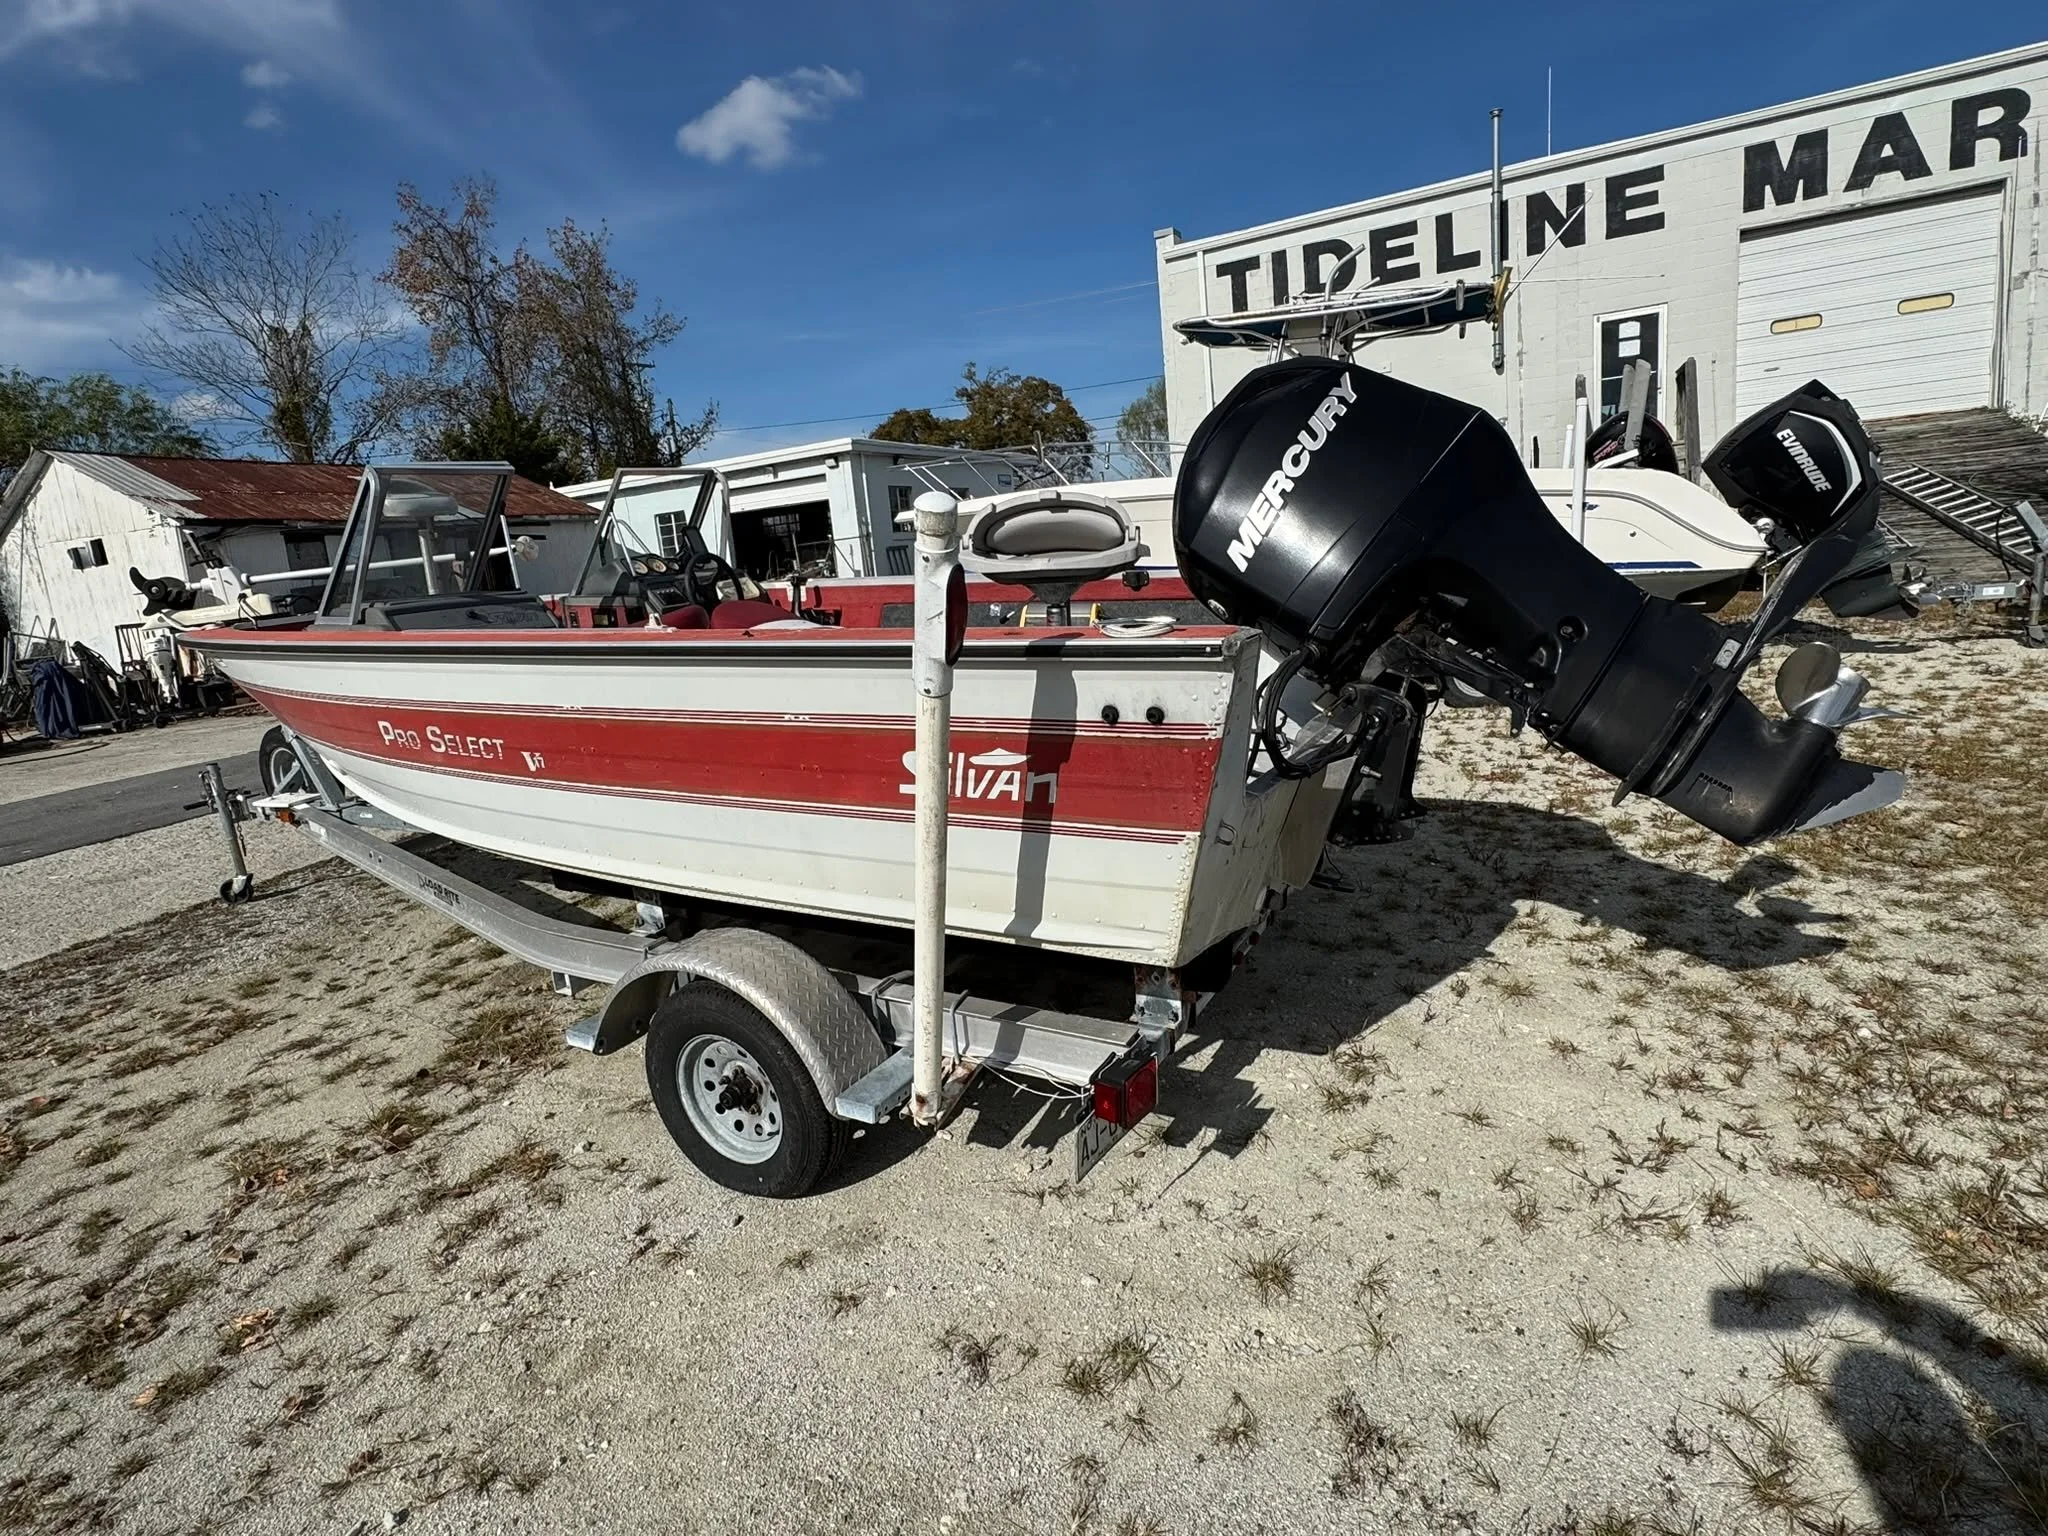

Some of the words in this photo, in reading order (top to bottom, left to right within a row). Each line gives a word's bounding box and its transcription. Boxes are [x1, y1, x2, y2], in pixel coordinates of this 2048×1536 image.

[1216, 164, 1666, 313] TIDELINE
[1743, 87, 2032, 213] MAR
[1226, 371, 1358, 573] MERCURY
[1776, 428, 1832, 492] EVINRUDE
